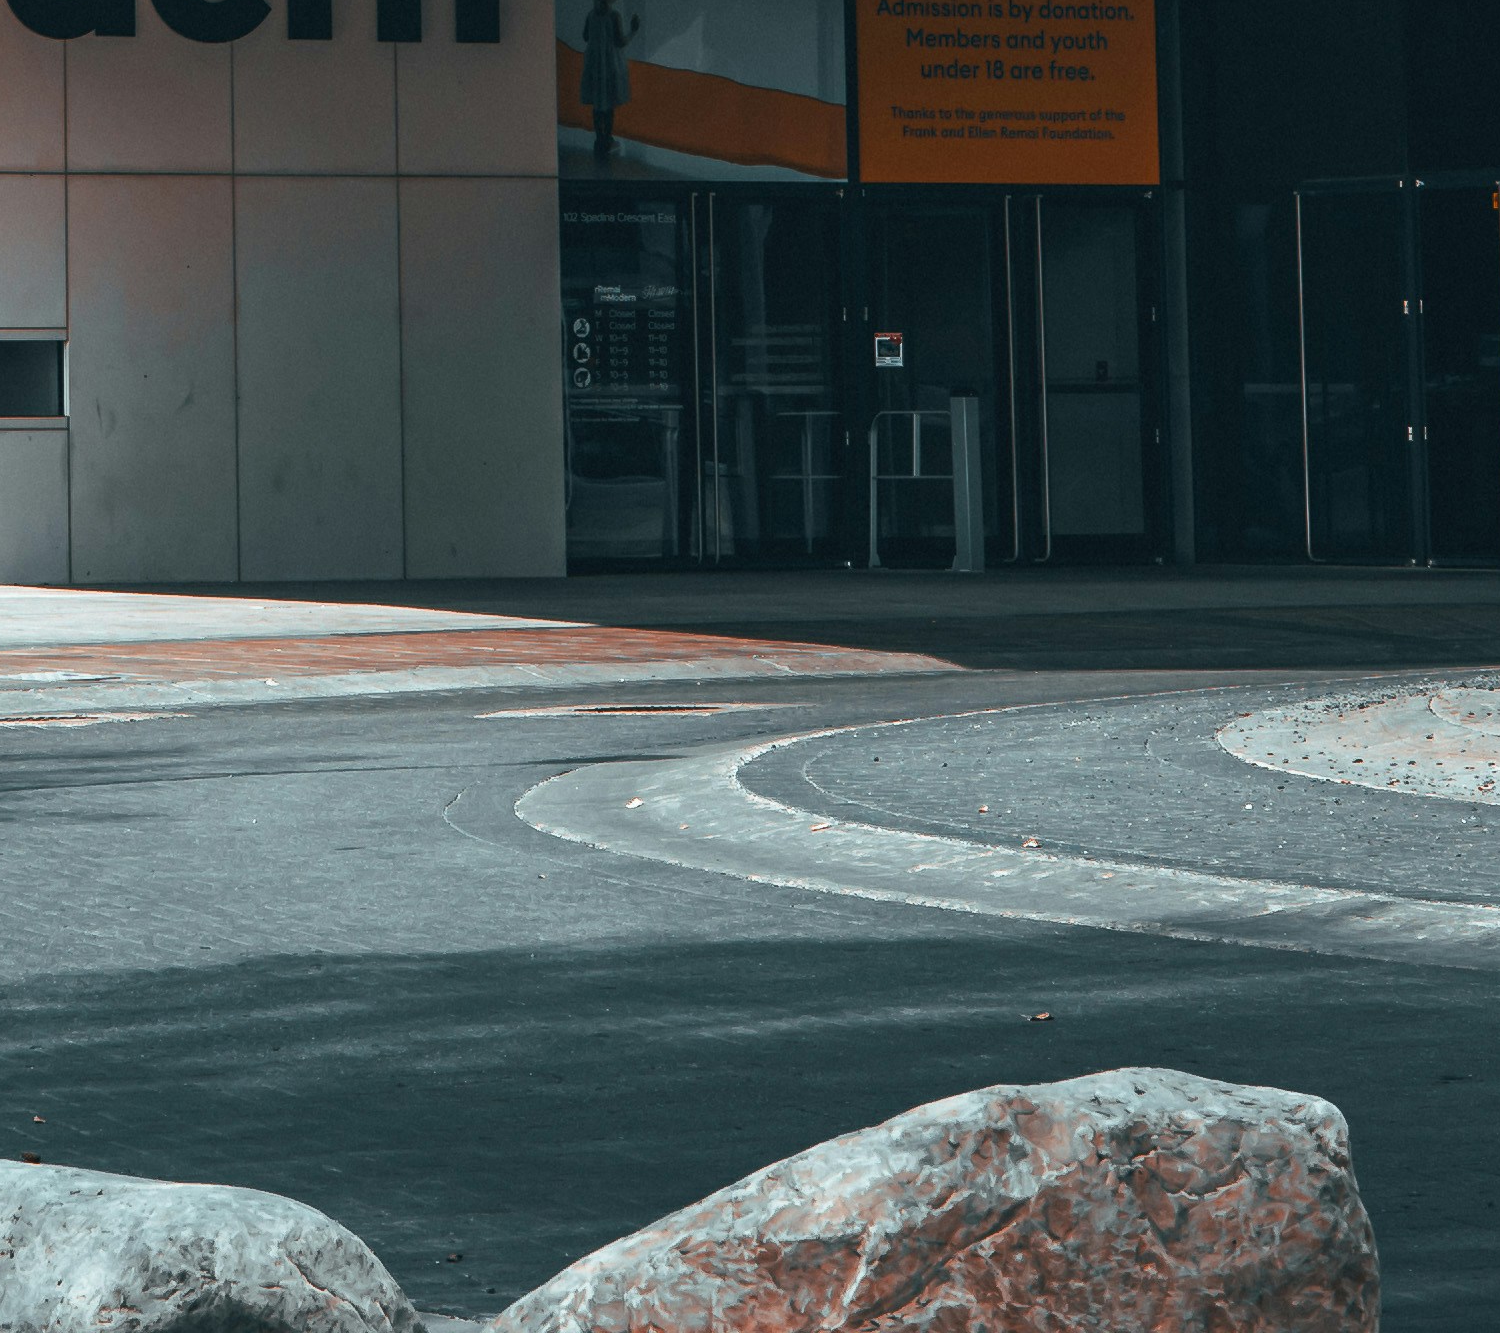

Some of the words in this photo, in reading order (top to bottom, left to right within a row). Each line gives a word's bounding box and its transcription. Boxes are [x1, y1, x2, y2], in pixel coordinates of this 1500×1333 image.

[989, 0, 1002, 18] is
[1008, 0, 1033, 22] by
[1039, 0, 1134, 21] donation.
[906, 28, 1001, 48] Members
[1006, 31, 1044, 49] and
[1050, 31, 1108, 54] youth
[920, 59, 979, 79] under
[985, 60, 1005, 80] 18
[1010, 63, 1044, 80] are
[1049, 60, 1096, 81] free.
[891, 106, 936, 120] Thanks
[938, 108, 952, 120] to
[955, 107, 975, 120] the
[979, 110, 1036, 123] generous
[1039, 109, 1087, 123] support
[1090, 108, 1103, 121] of
[1106, 108, 1125, 122] the
[902, 125, 937, 138] Frank
[941, 125, 964, 138] and
[968, 125, 996, 139] Ellen
[1000, 126, 1038, 139] Remai
[563, 213, 578, 222] 102
